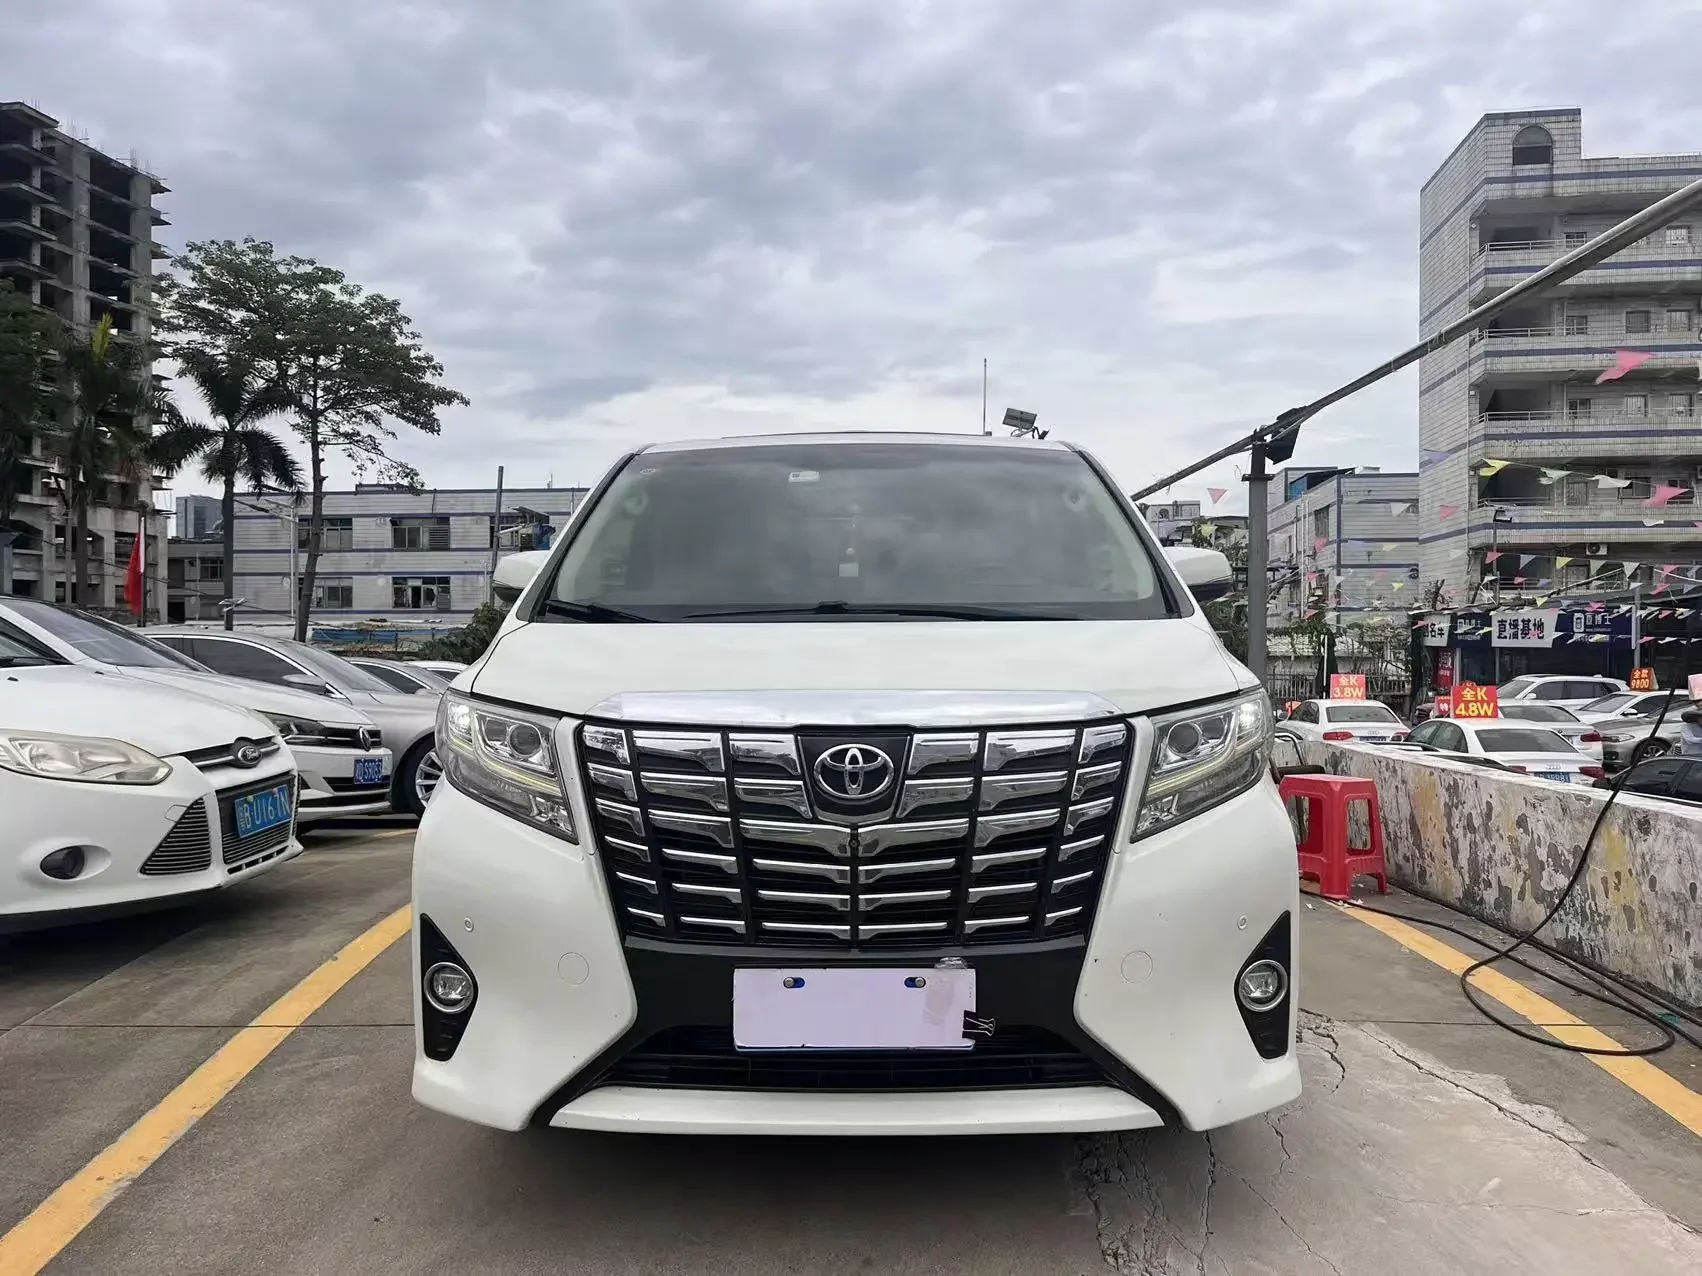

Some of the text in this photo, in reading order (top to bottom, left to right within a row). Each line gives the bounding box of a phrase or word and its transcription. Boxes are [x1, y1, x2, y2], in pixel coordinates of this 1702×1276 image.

[1497, 618, 1545, 640] 直播基地
[1338, 675, 1359, 686] 全K
[1631, 679, 1650, 689] 9800
[1333, 687, 1364, 698] 3.8W
[1461, 687, 1489, 701] 全K
[1455, 702, 1495, 717] 4.8W
